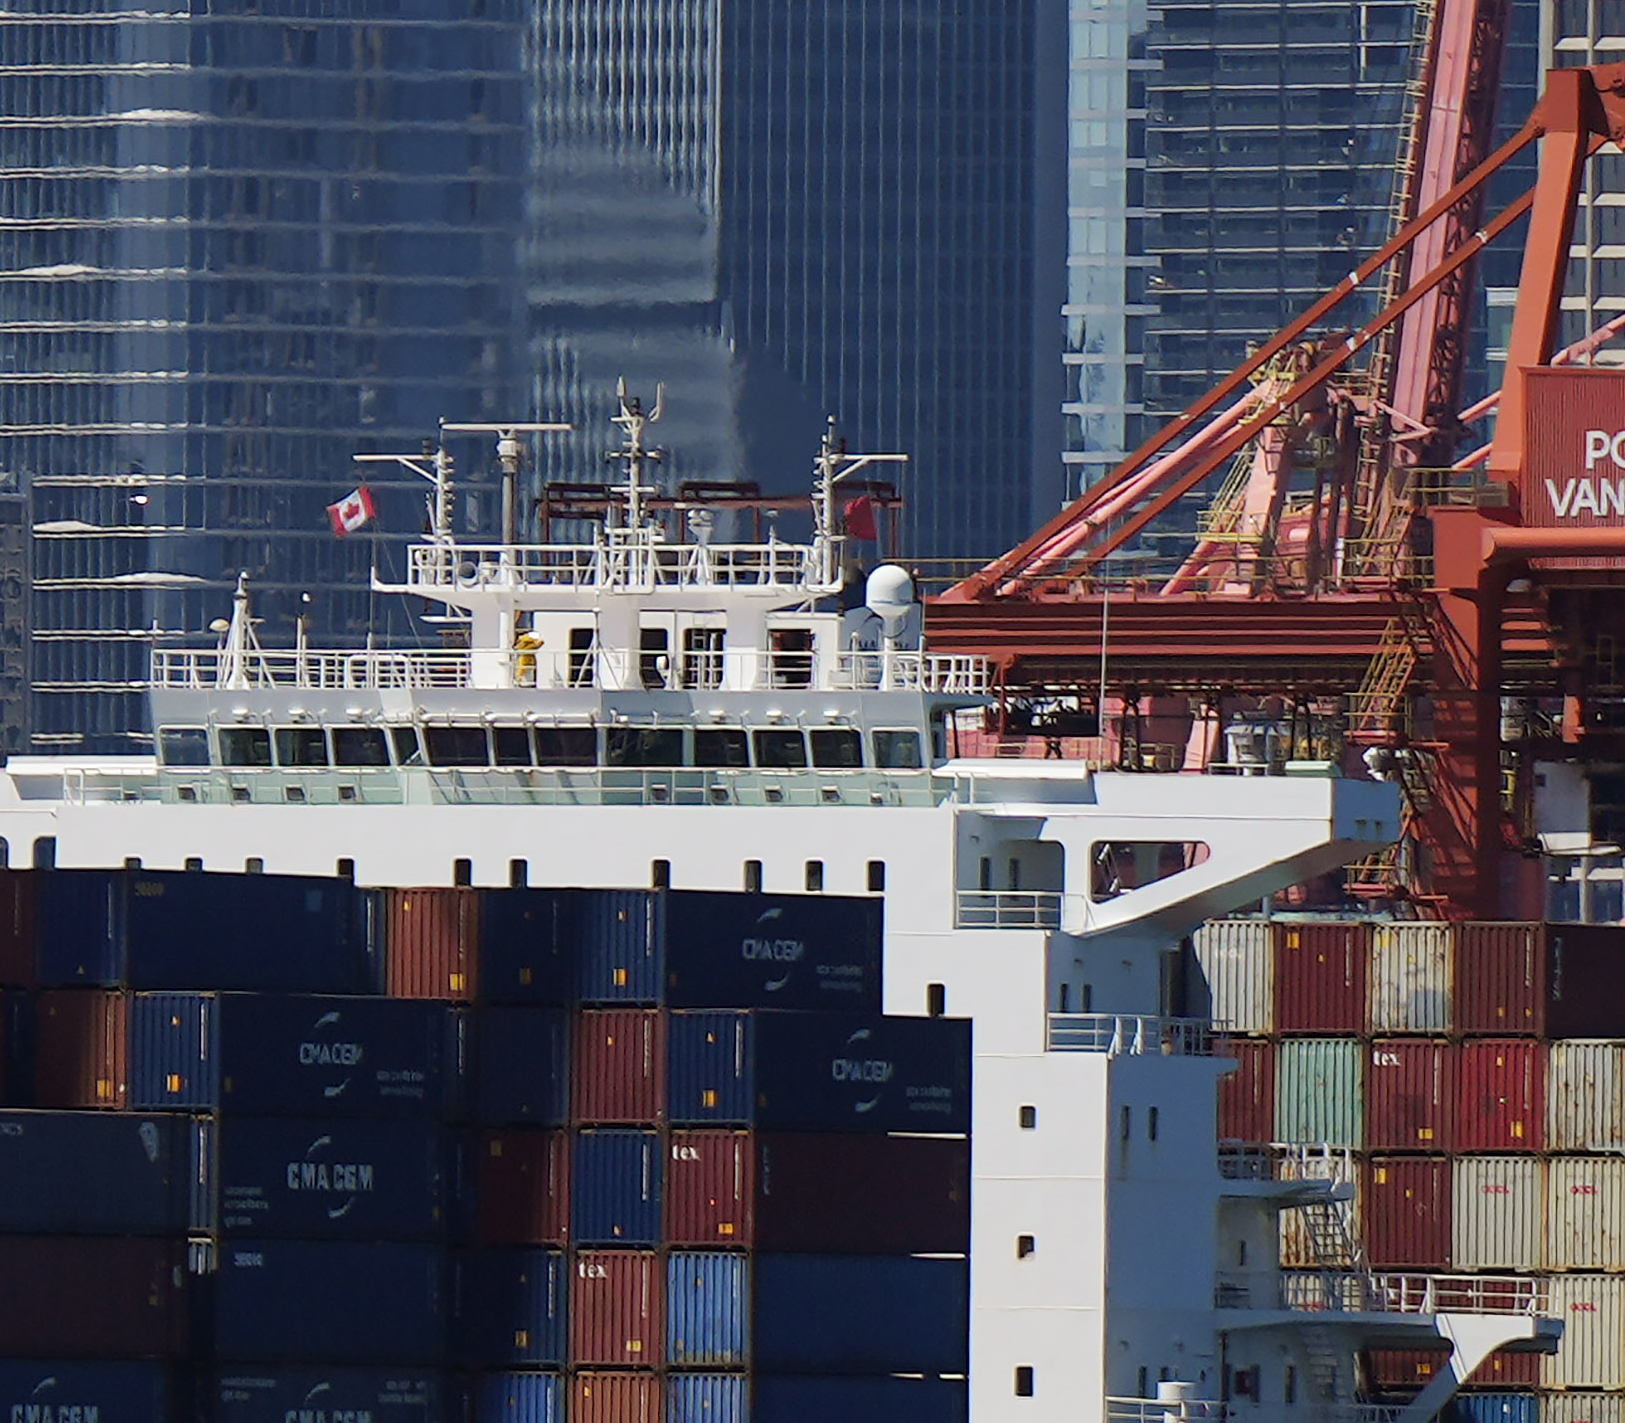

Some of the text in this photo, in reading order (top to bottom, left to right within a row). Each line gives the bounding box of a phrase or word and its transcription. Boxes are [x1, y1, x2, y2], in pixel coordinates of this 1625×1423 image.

[1373, 1050, 1403, 1066] tex
[672, 1144, 701, 1161] tex
[286, 1162, 373, 1191] CMA CGM
[578, 1261, 607, 1280] tex
